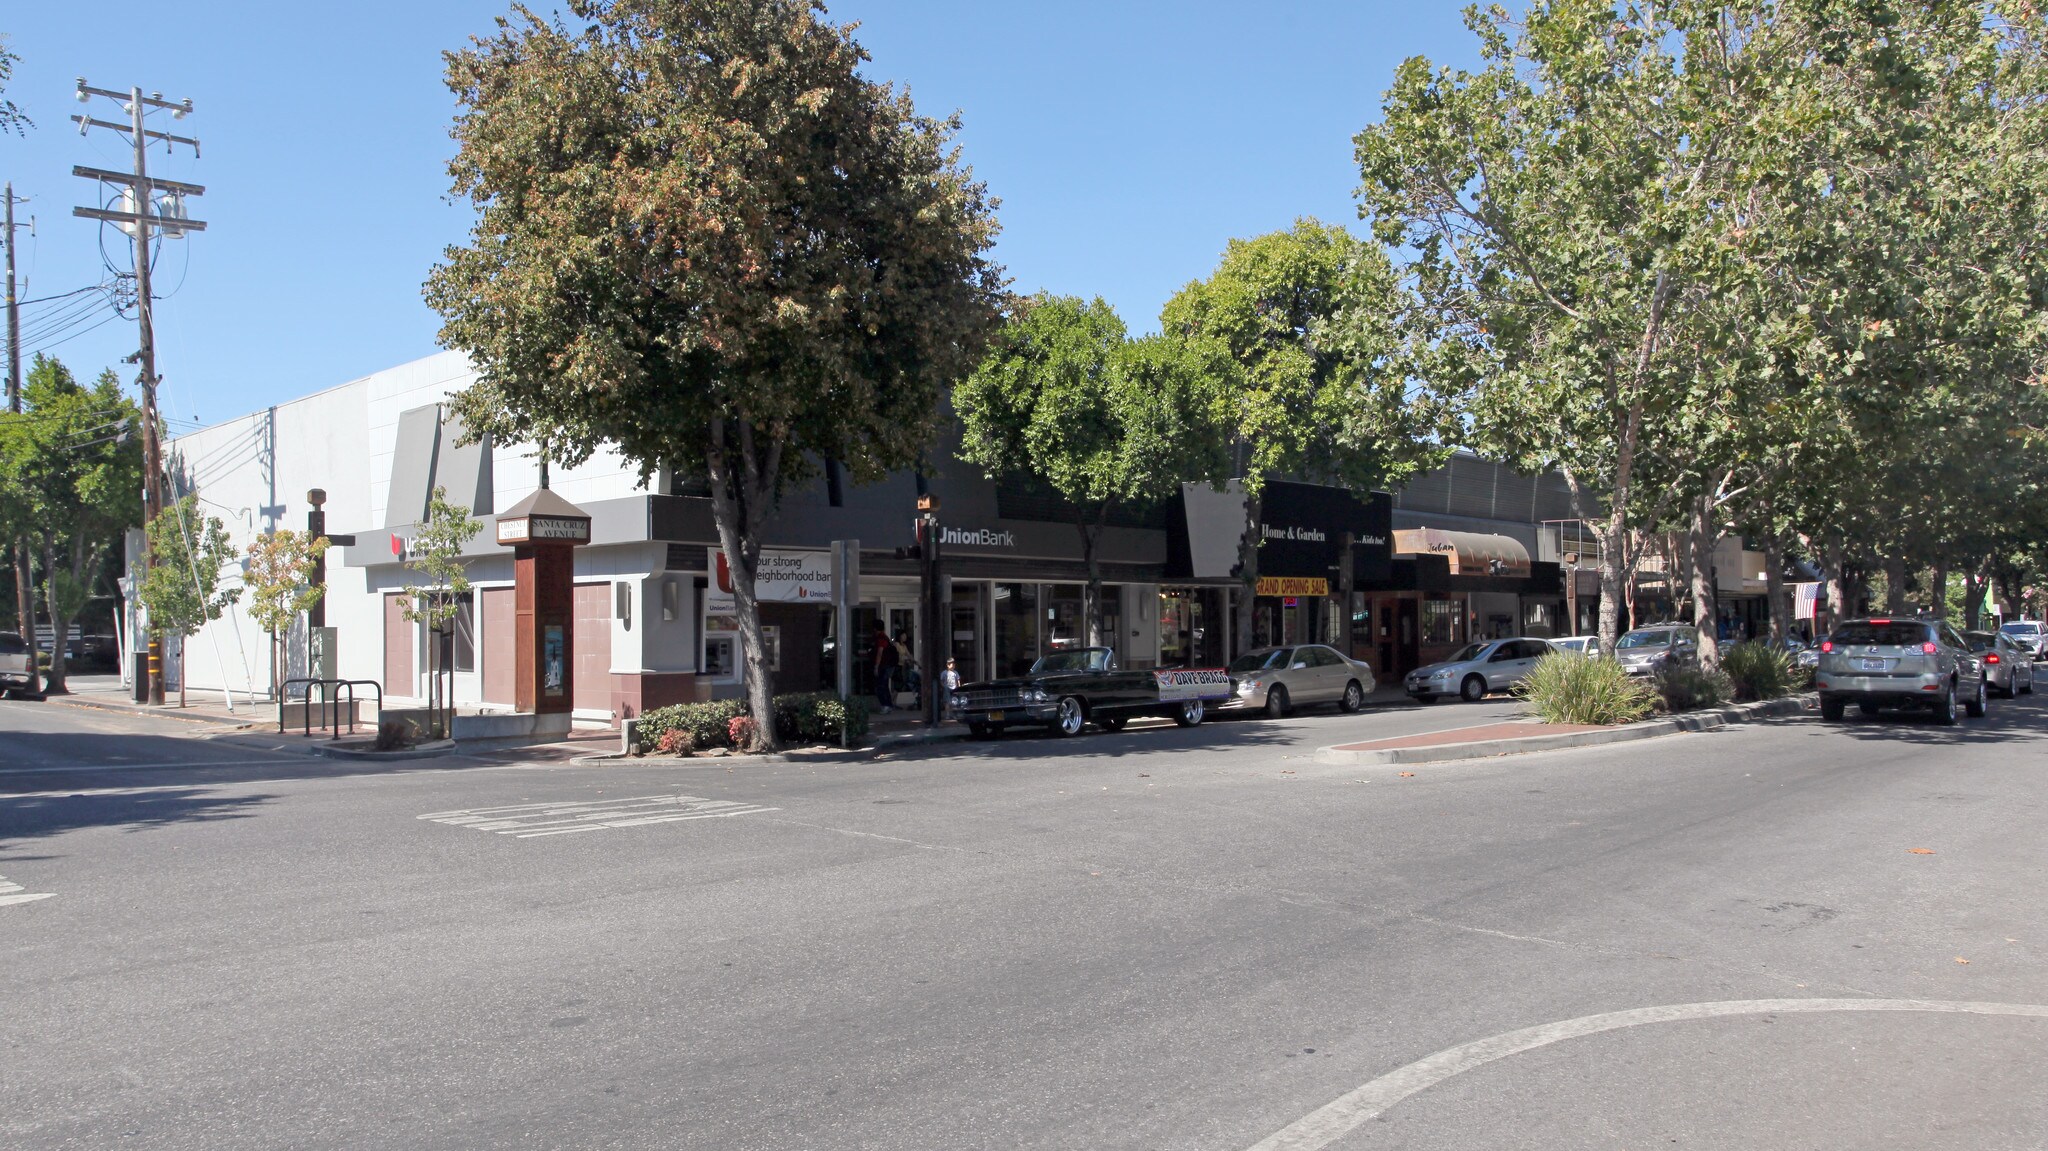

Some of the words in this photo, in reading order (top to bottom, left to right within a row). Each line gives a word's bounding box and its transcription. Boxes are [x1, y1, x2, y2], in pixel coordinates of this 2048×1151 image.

[532, 520, 560, 529] SANTA
[563, 521, 586, 530] CRUZ
[504, 529, 523, 538] STREET
[543, 530, 577, 539] AVENUE
[1261, 523, 1286, 540] Home
[1287, 526, 1295, 540] &
[1296, 526, 1326, 542] Garden
[773, 555, 802, 569] strong
[756, 569, 814, 583] eighborhood
[1281, 578, 1310, 595] OPENING
[1311, 579, 1325, 594] SALE
[1174, 671, 1198, 685] DAVE
[1198, 670, 1229, 684] BRAGG
